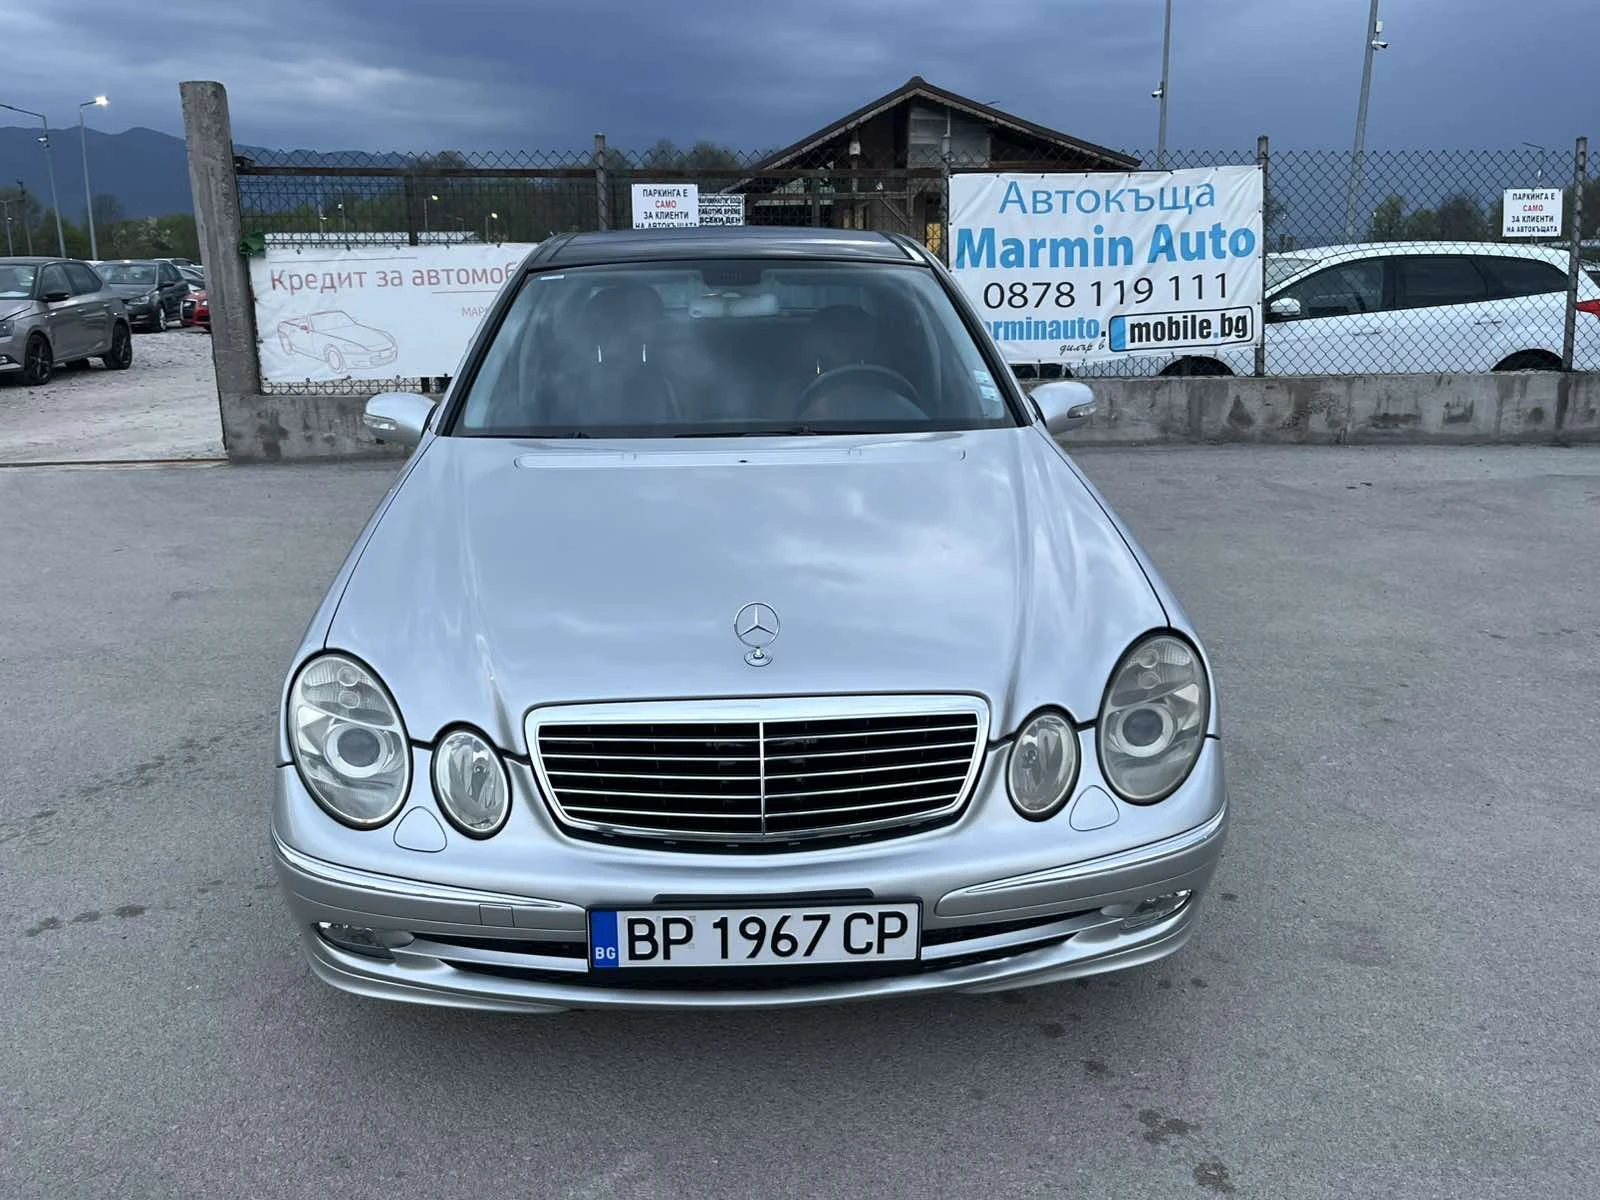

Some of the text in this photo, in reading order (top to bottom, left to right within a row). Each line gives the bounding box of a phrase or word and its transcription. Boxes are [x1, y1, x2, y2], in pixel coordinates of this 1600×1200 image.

[643, 188, 688, 197] ПАРКИНГА Е
[999, 180, 1216, 215] Автокъща
[1512, 192, 1556, 200] ПАРКИНГА Е
[655, 200, 677, 208] САМО
[1522, 204, 1544, 212] САМО
[643, 211, 689, 220] ЗА КЛИЕНТИ
[1511, 215, 1554, 223] ЗА КЛИЕНТИ
[1506, 225, 1558, 233] НА АВТОКЪЩАТА
[955, 222, 1256, 270] Marmin Auto
[270, 269, 367, 296] Кредит
[376, 269, 403, 288] за
[983, 273, 1227, 309] 0878 119 111
[1129, 313, 1248, 344] mobile.bg
[627, 910, 908, 961] BP 1967 CP
[595, 946, 616, 960] BG
